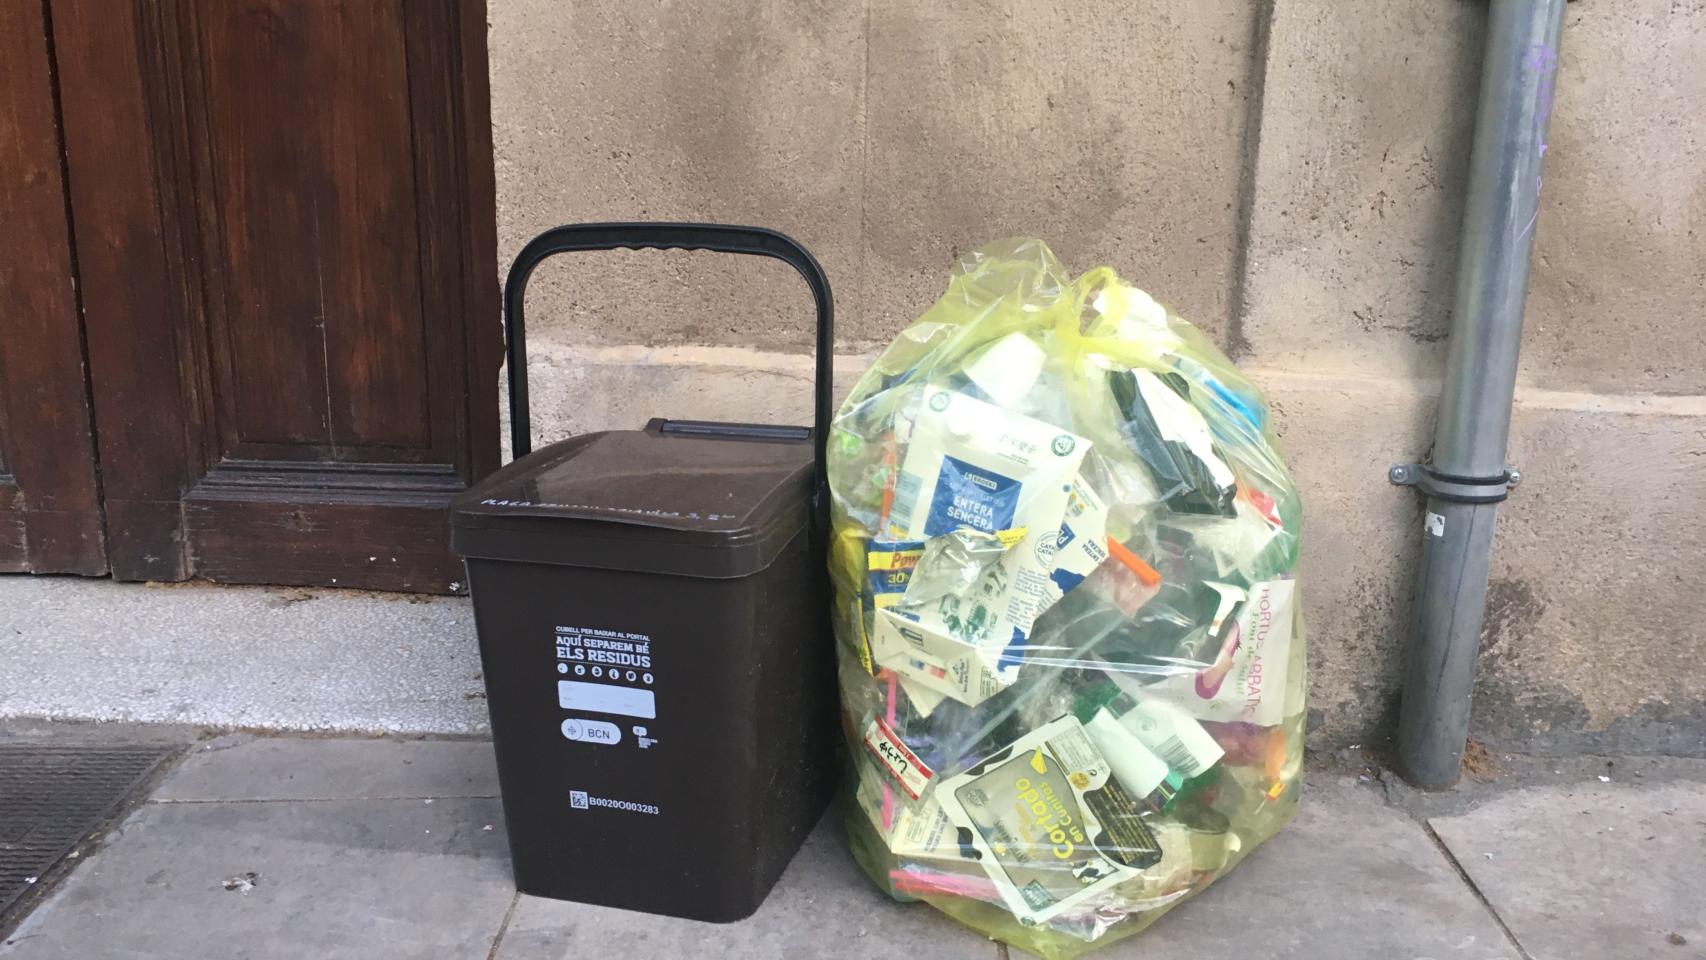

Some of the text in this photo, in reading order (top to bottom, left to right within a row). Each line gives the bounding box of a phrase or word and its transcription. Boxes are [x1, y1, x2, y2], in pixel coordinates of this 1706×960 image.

[953, 495, 993, 518] ENTERA
[946, 505, 993, 530] SENCERA
[555, 625, 580, 634] CUBELL
[580, 627, 594, 636] PER
[593, 629, 617, 638] BAIXAR
[626, 633, 650, 642] PORTAL
[556, 634, 650, 655] AQUÍ SEPAREM BÉ
[556, 646, 651, 668] ELS RESIDUS
[587, 728, 611, 740] BCN
[1015, 778, 1074, 859] Cortado
[1069, 825, 1084, 843] en
